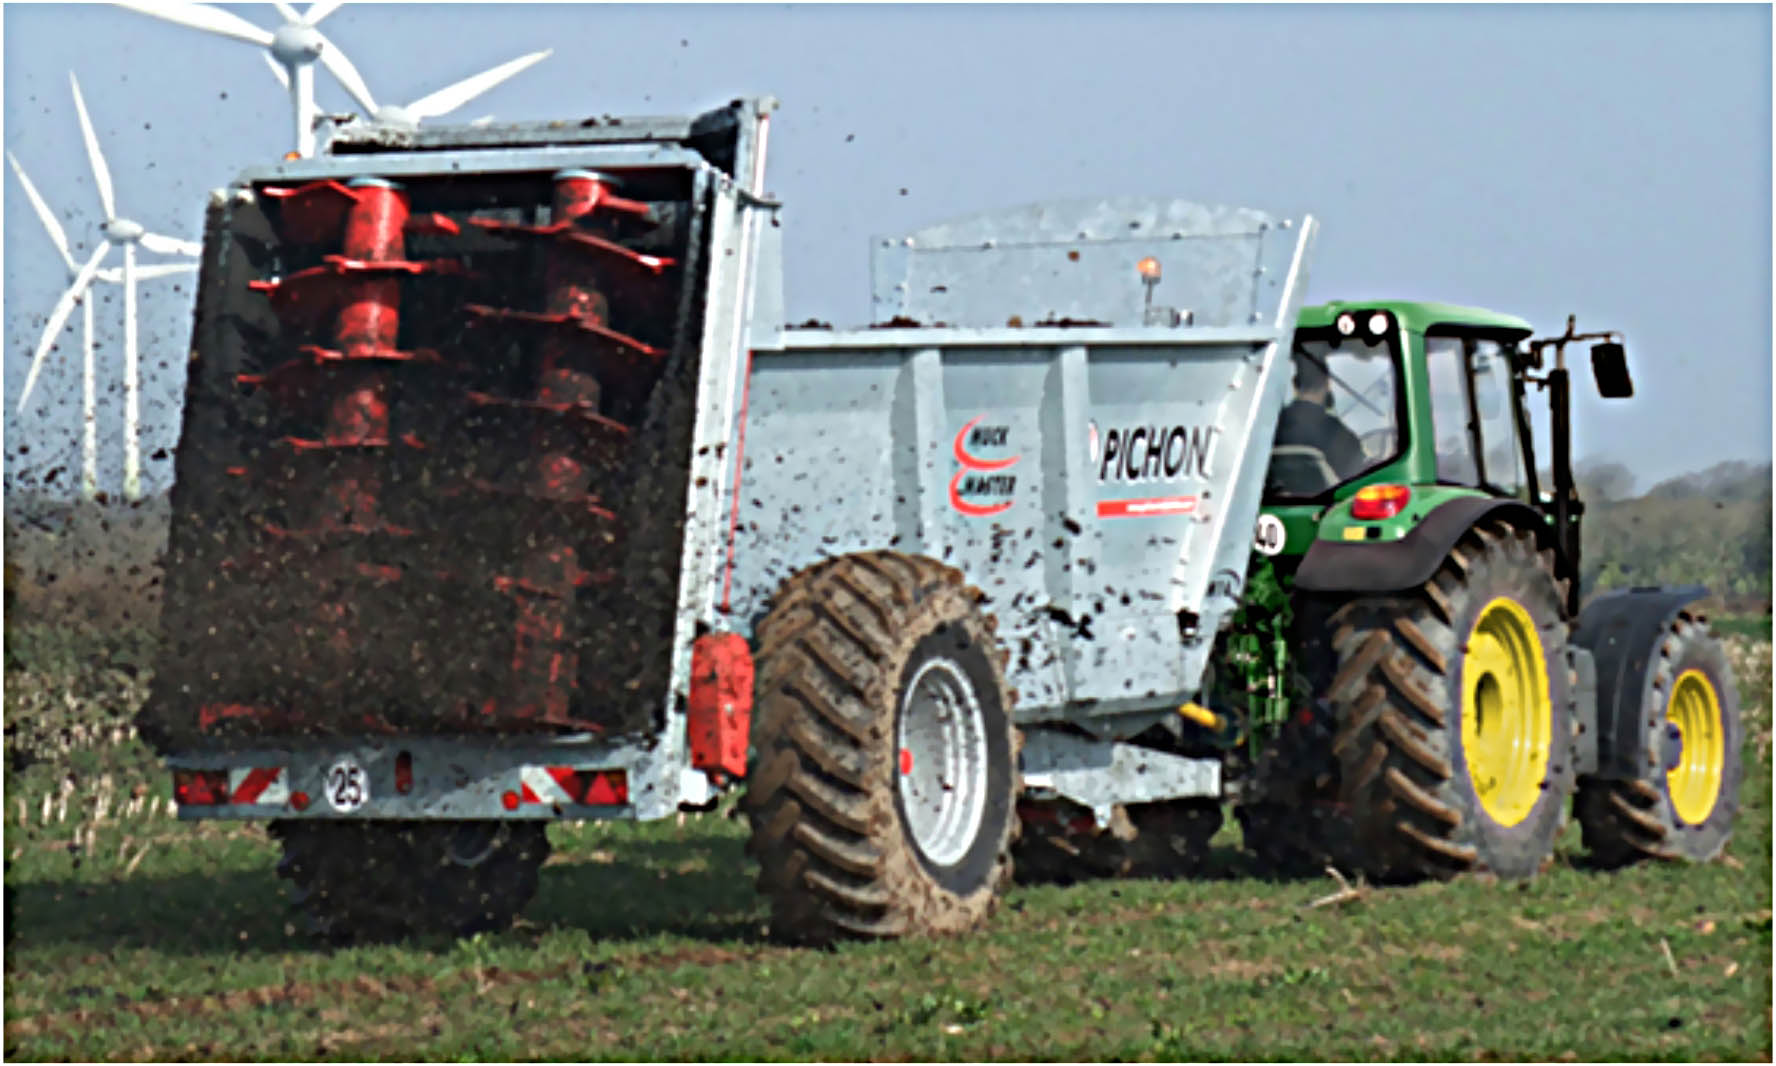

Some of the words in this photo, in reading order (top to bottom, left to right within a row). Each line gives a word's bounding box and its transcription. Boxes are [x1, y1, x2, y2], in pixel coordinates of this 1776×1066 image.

[970, 426, 1009, 446] MUCK
[1099, 425, 1213, 480] PICHON
[963, 475, 1017, 496] MASTER
[335, 767, 361, 805] 25
